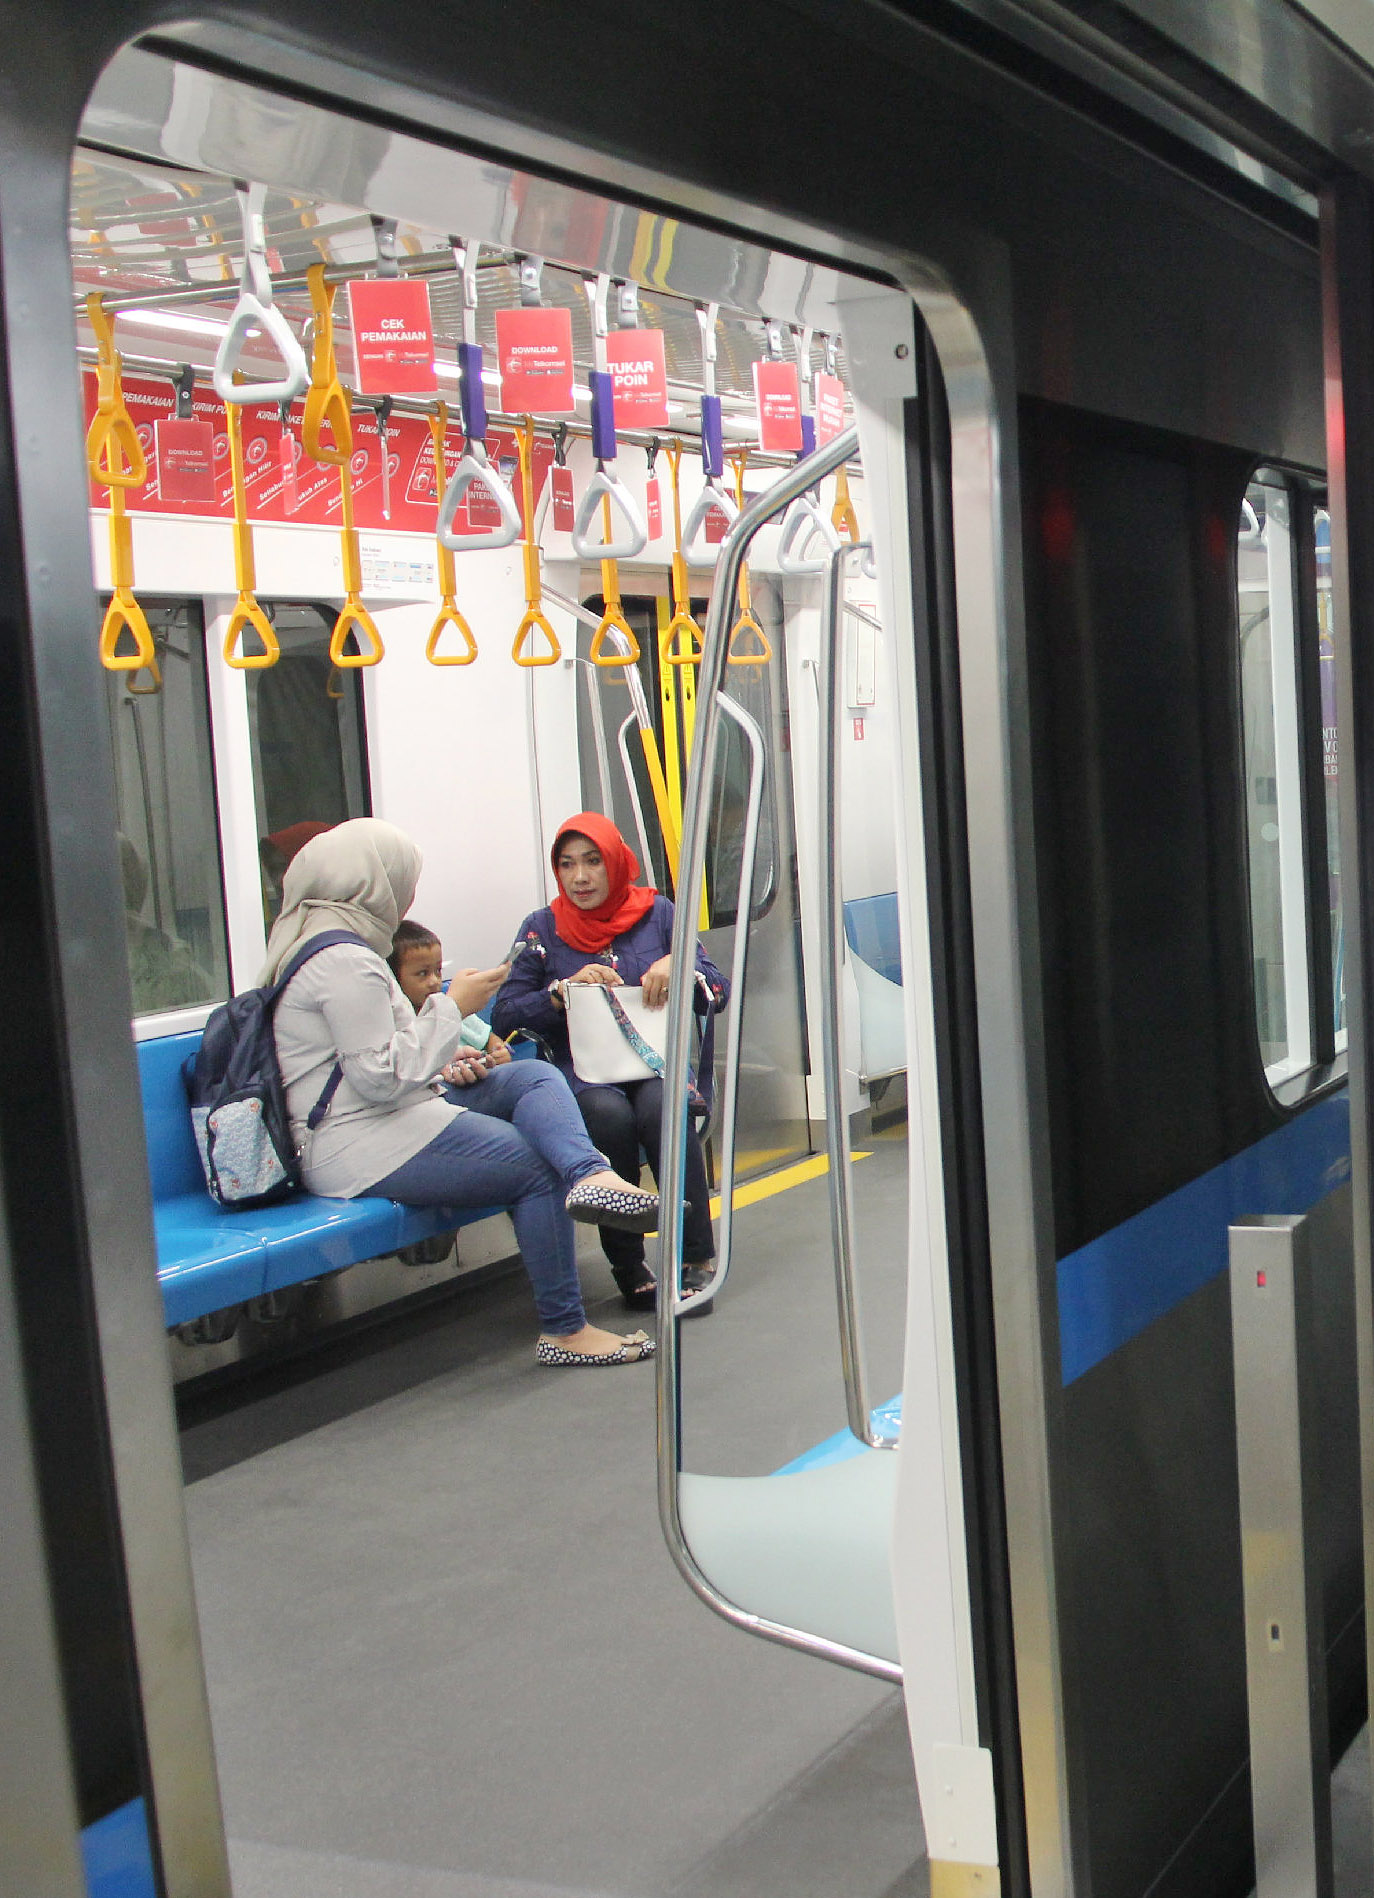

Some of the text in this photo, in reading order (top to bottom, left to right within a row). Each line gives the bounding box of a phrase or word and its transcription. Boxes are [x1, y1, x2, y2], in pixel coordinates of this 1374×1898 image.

[380, 319, 405, 329] CEK
[361, 331, 427, 342] PEMAKAIAN
[511, 346, 559, 354] DOWNLOAD
[606, 361, 654, 374] TUKAR
[614, 374, 648, 386] POIN
[122, 392, 174, 408] PEMAKAIAN
[357, 424, 378, 434] TUKA
[259, 479, 285, 501] Setiabu
